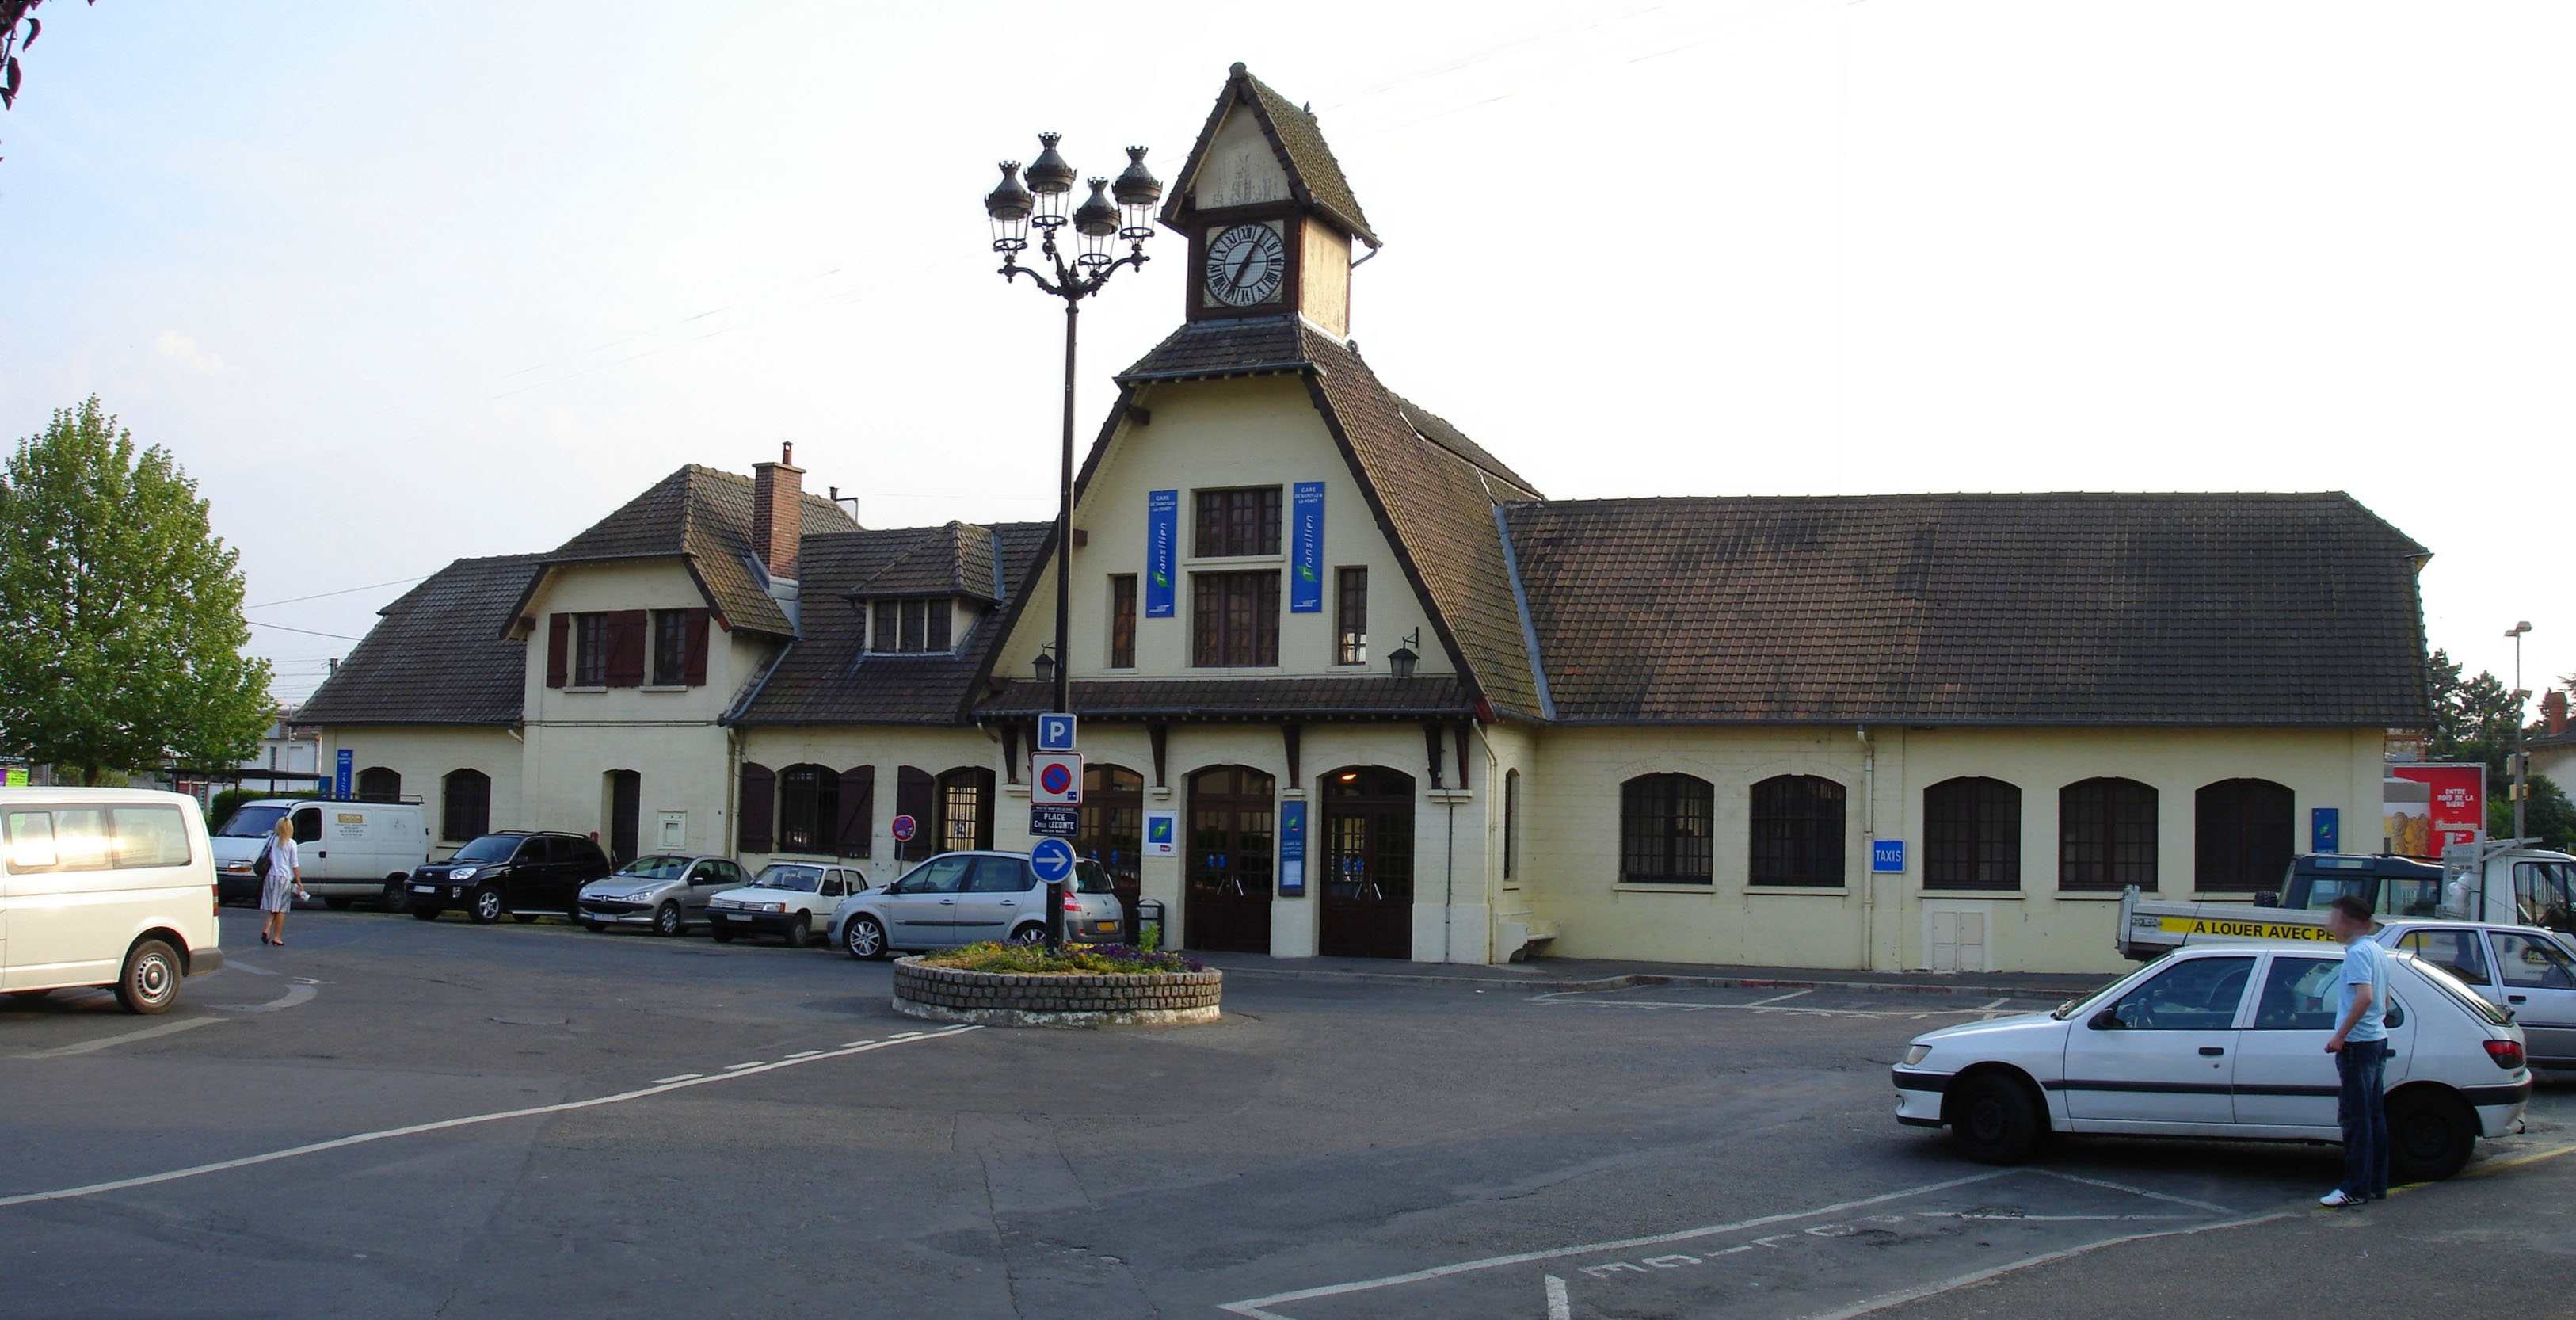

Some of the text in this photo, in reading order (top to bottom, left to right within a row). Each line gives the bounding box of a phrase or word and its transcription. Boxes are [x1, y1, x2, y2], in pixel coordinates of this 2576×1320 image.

[1157, 522, 1167, 582] Transilien
[1303, 514, 1313, 577] Transilien
[1050, 721, 1065, 743] P
[1044, 812, 1066, 821] PLACE
[1876, 850, 1902, 862] TAXIS
[2193, 921, 2335, 942] A LOUER AVEC PE
